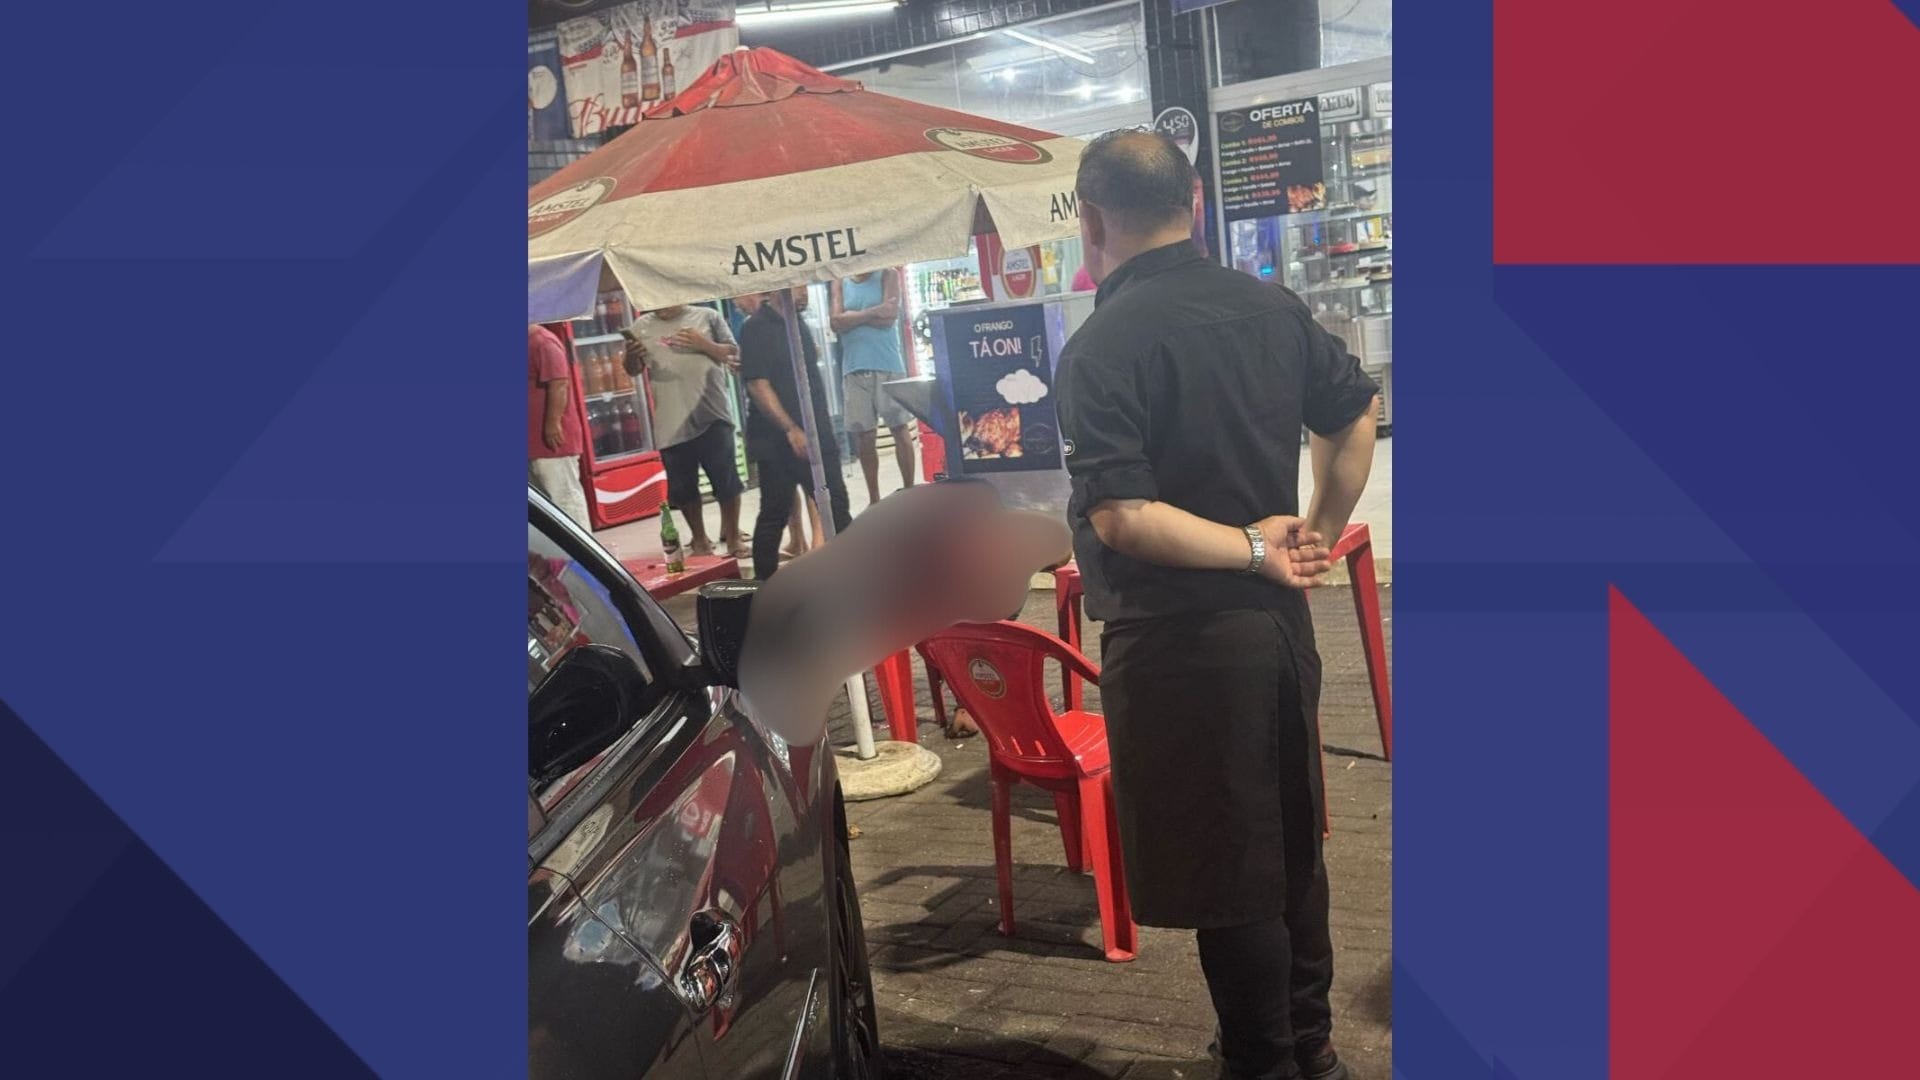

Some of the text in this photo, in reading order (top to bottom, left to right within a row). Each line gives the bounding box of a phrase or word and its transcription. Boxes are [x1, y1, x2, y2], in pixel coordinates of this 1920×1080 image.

[1249, 101, 1315, 122] OFERTA
[1262, 115, 1306, 129] DE COMBOS
[731, 227, 867, 275] AMSTEL
[974, 320, 1014, 333] O FRANGO
[968, 336, 1022, 358] TÁ ON!
